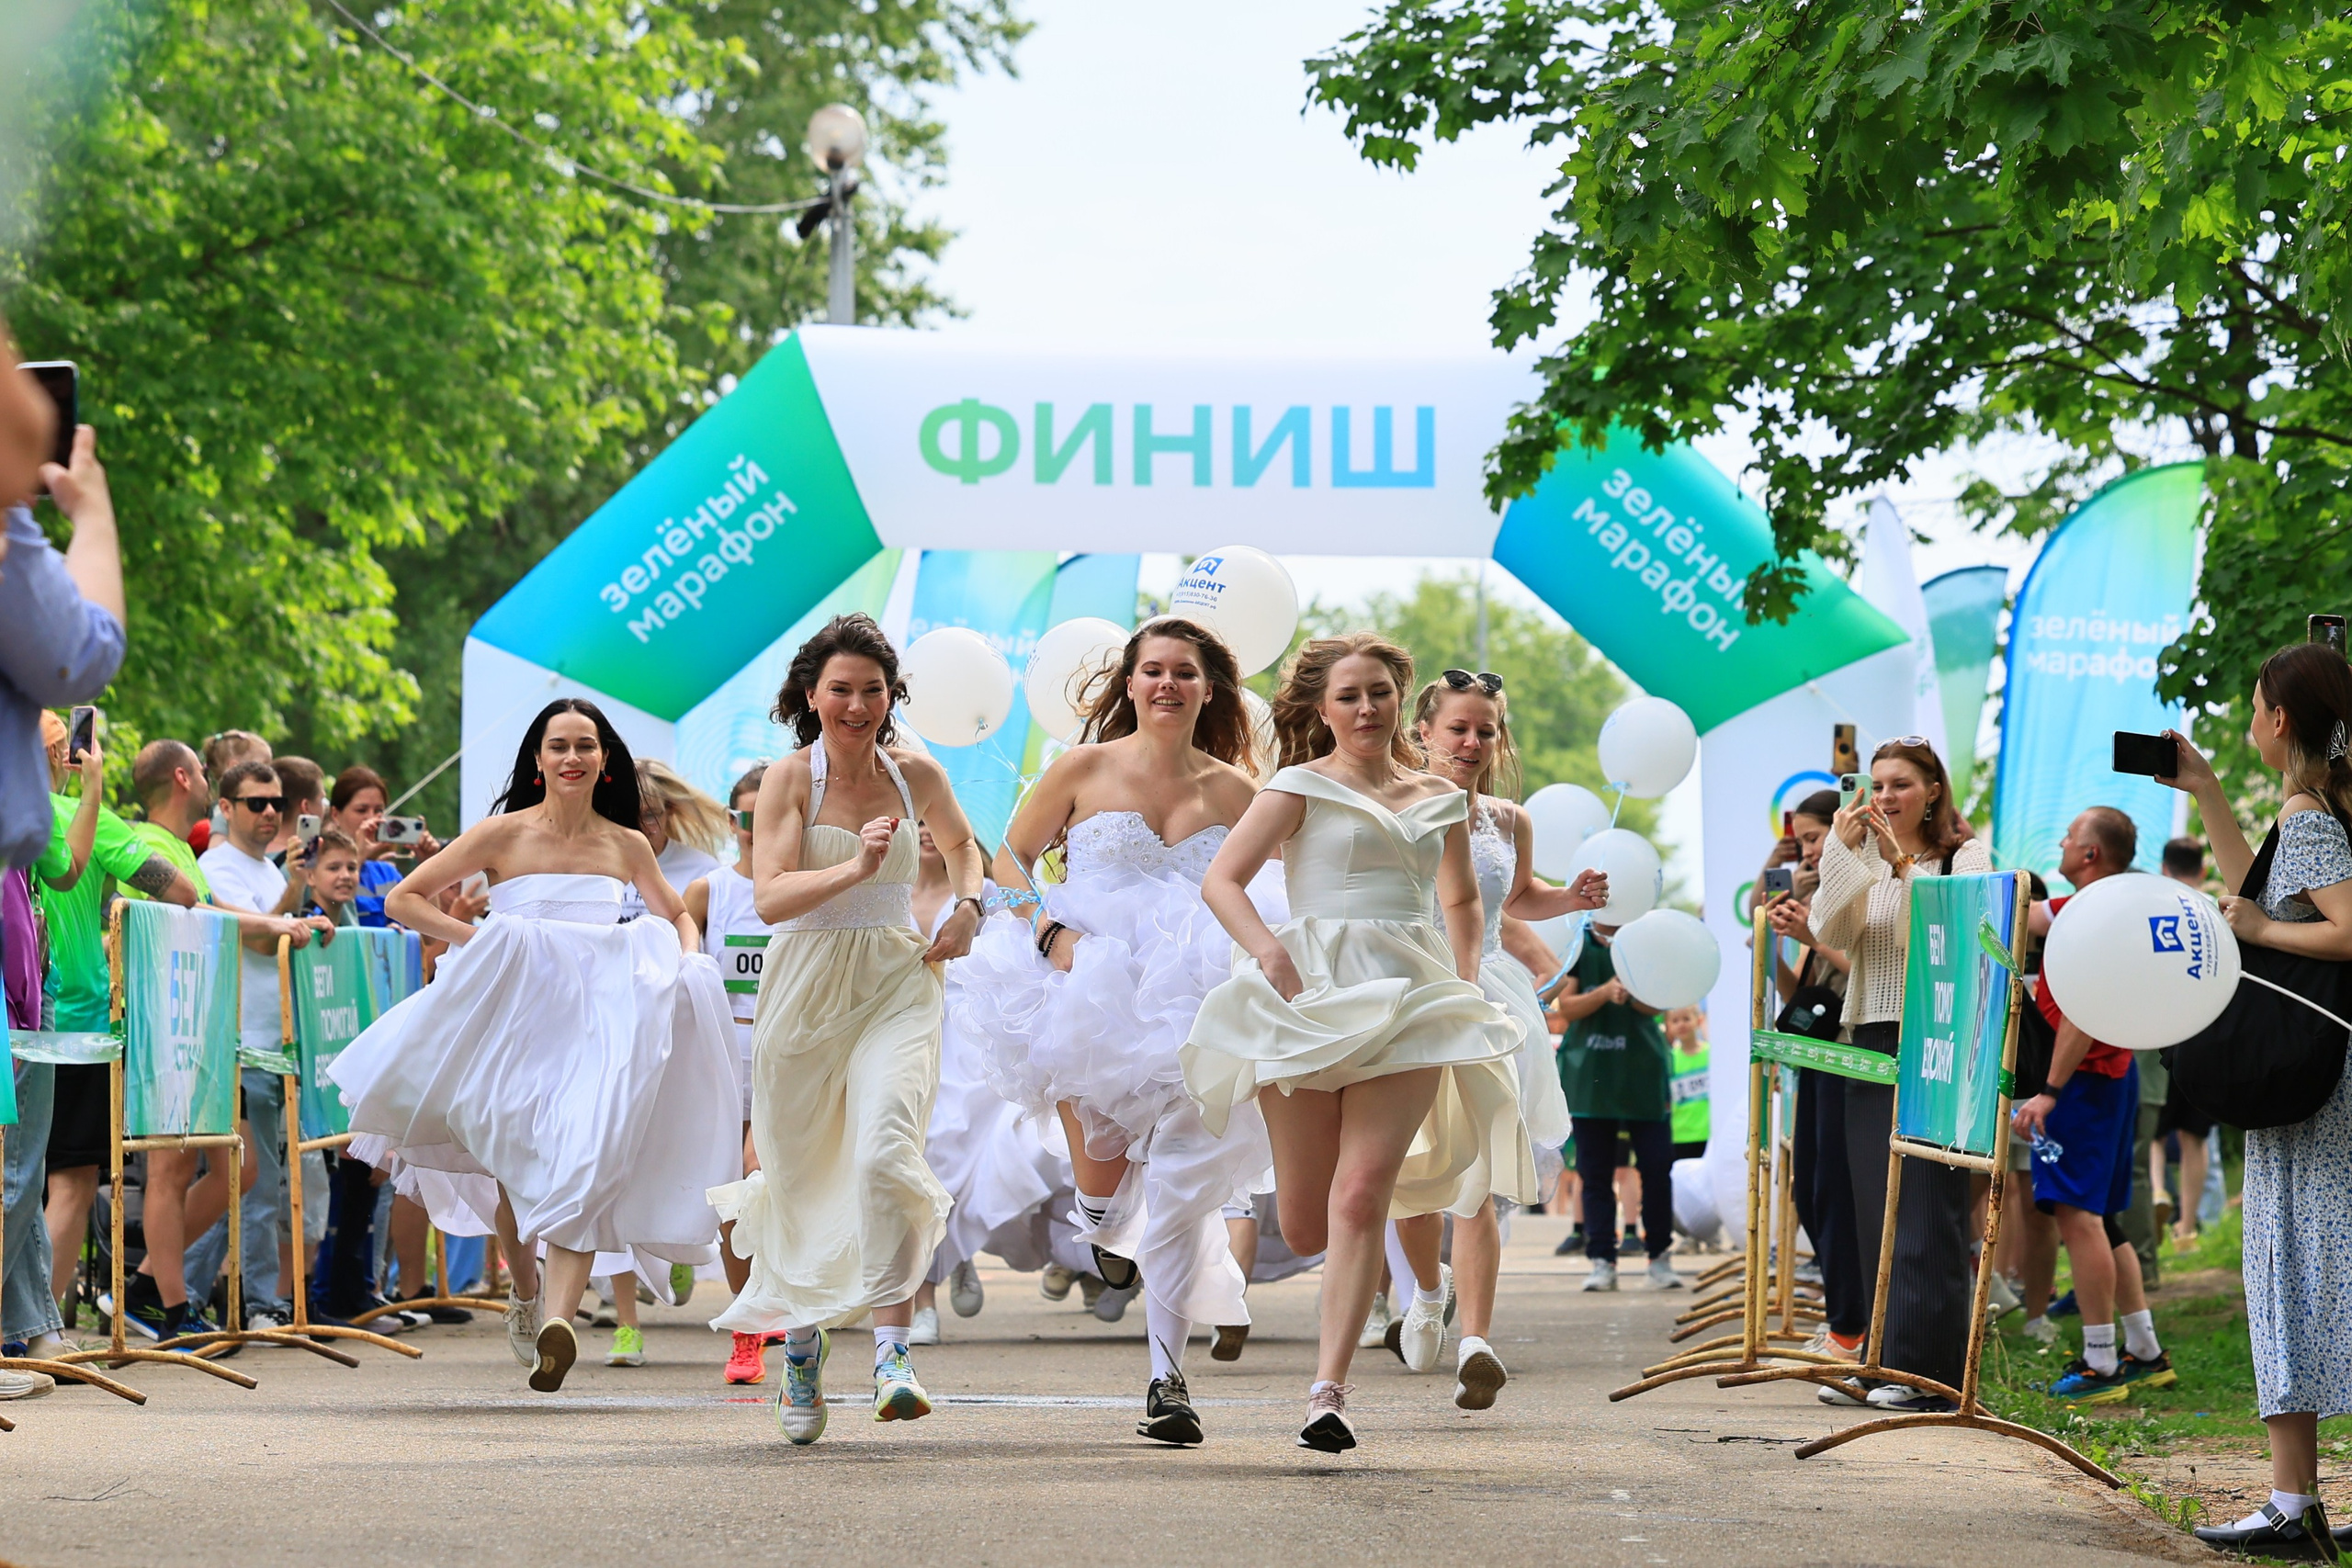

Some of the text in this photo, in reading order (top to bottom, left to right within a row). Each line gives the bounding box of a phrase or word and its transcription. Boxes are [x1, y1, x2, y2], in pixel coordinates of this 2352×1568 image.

[919, 398, 1436, 489] ФИНИШ
[599, 453, 770, 614] зелёный
[627, 491, 798, 644] марафон
[1571, 497, 1741, 652] марафон
[1177, 577, 1227, 593] Акцент
[2027, 646, 2160, 684] марафо
[2030, 610, 2182, 645] зелёный
[736, 953, 763, 975] 00
[2177, 896, 2203, 980] Акцент
